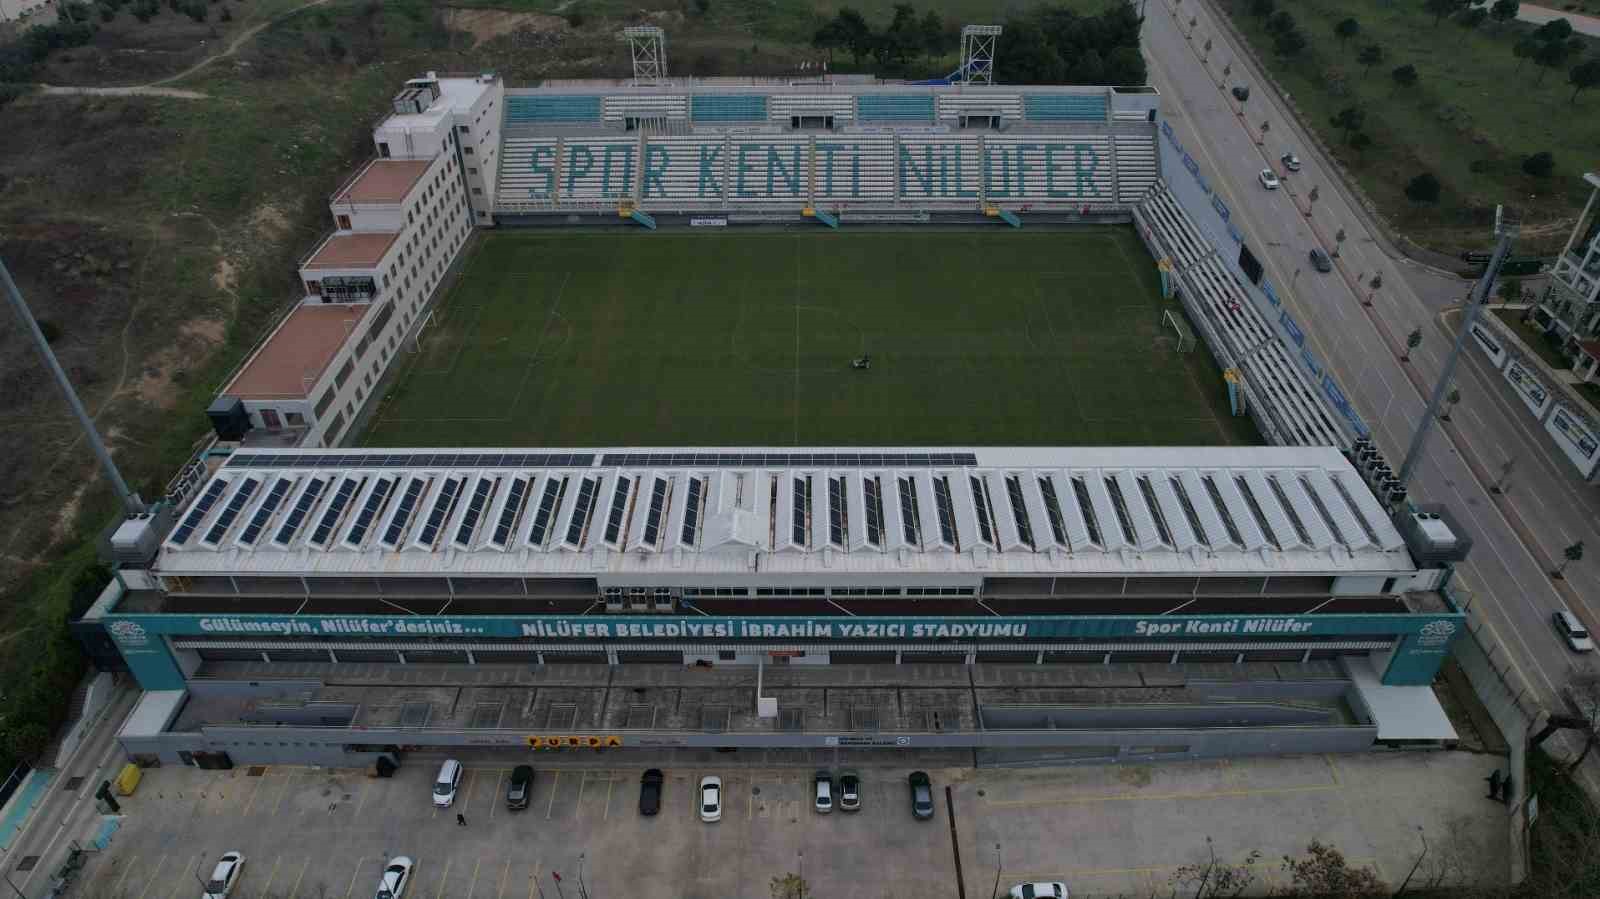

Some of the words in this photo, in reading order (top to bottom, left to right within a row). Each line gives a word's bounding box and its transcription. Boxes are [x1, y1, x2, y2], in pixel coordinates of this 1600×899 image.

[529, 143, 672, 199] SPOR
[200, 617, 319, 634] Gülümseyin,
[521, 620, 610, 638] NİLÜFER
[615, 620, 734, 638] BELEDİYESİ
[741, 621, 832, 638] İBRAHİM
[839, 623, 906, 638] YAZICI
[911, 623, 1028, 638] STADYUMU
[1135, 620, 1181, 636] Spor
[1185, 619, 1239, 634] Kenti
[1242, 618, 1313, 633] Nilüfer
